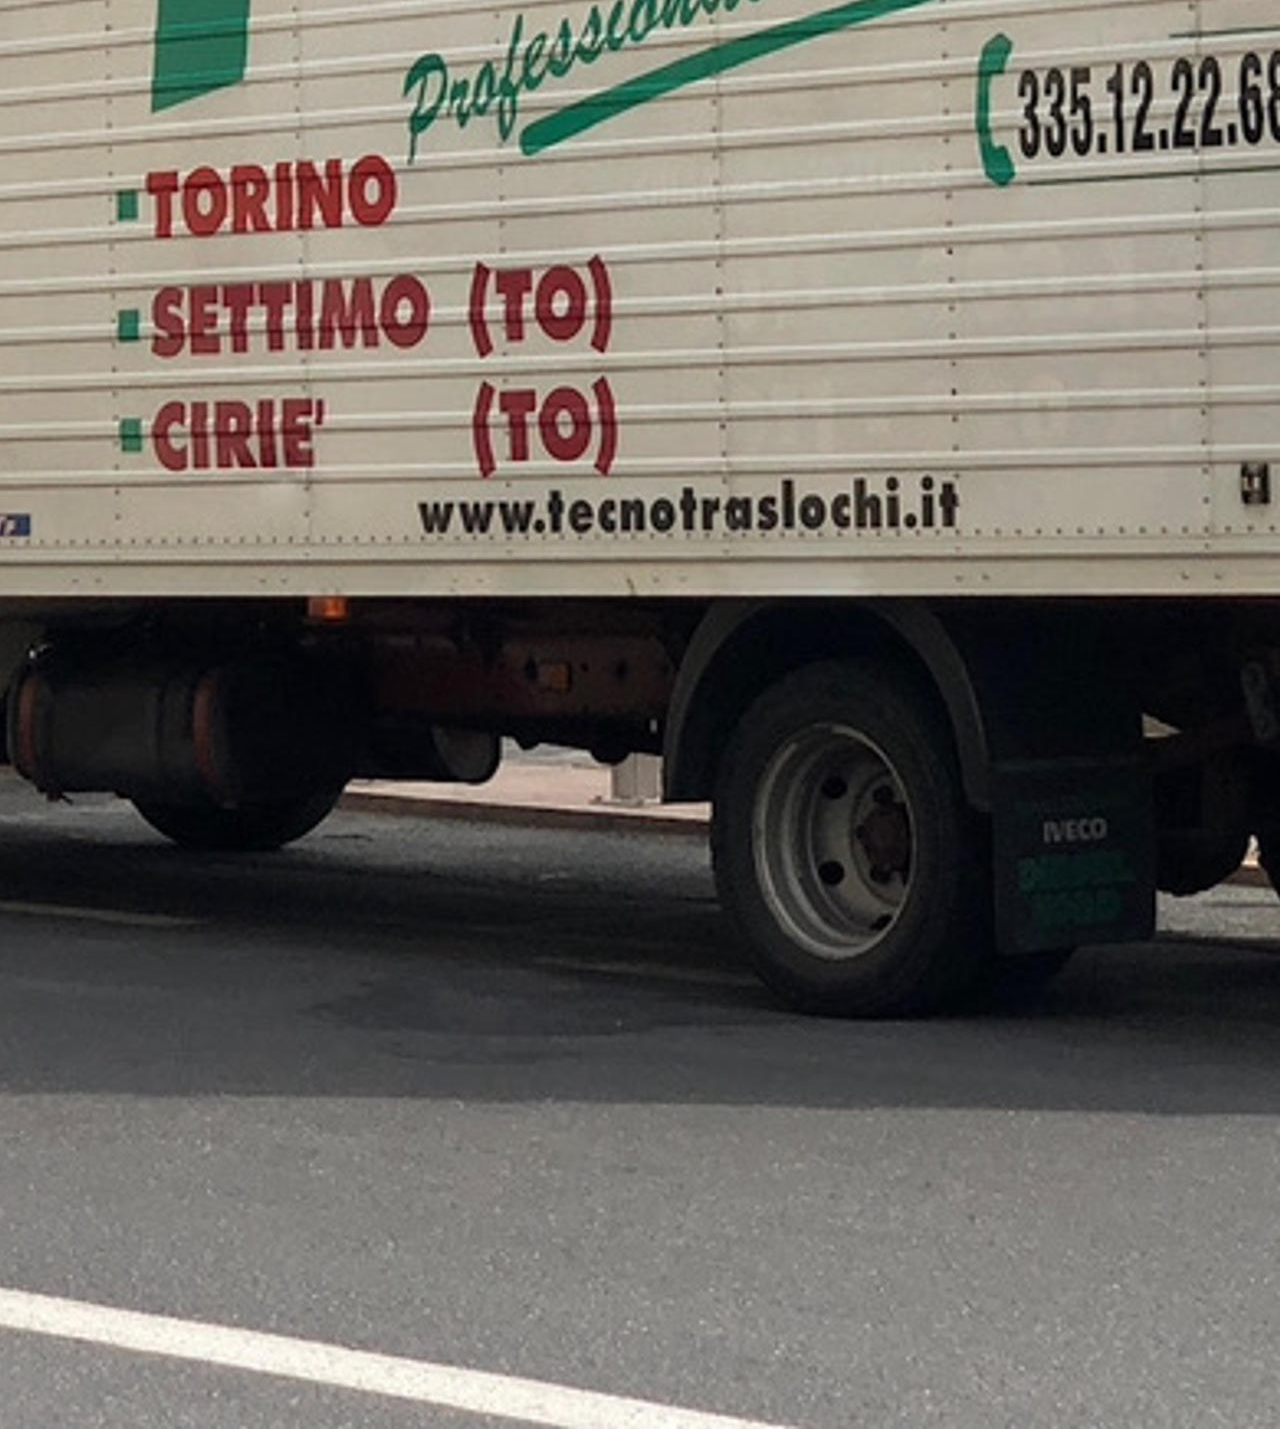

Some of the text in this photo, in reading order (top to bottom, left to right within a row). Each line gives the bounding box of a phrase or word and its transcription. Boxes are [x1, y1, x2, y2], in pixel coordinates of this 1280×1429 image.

[146, 154, 398, 238] TORINO
[151, 255, 613, 359] SETTIMO (TO)
[472, 376, 619, 478] (TO)
[419, 476, 959, 535] www.tecnotraslochi.it
[1042, 818, 1108, 844] IVECO
